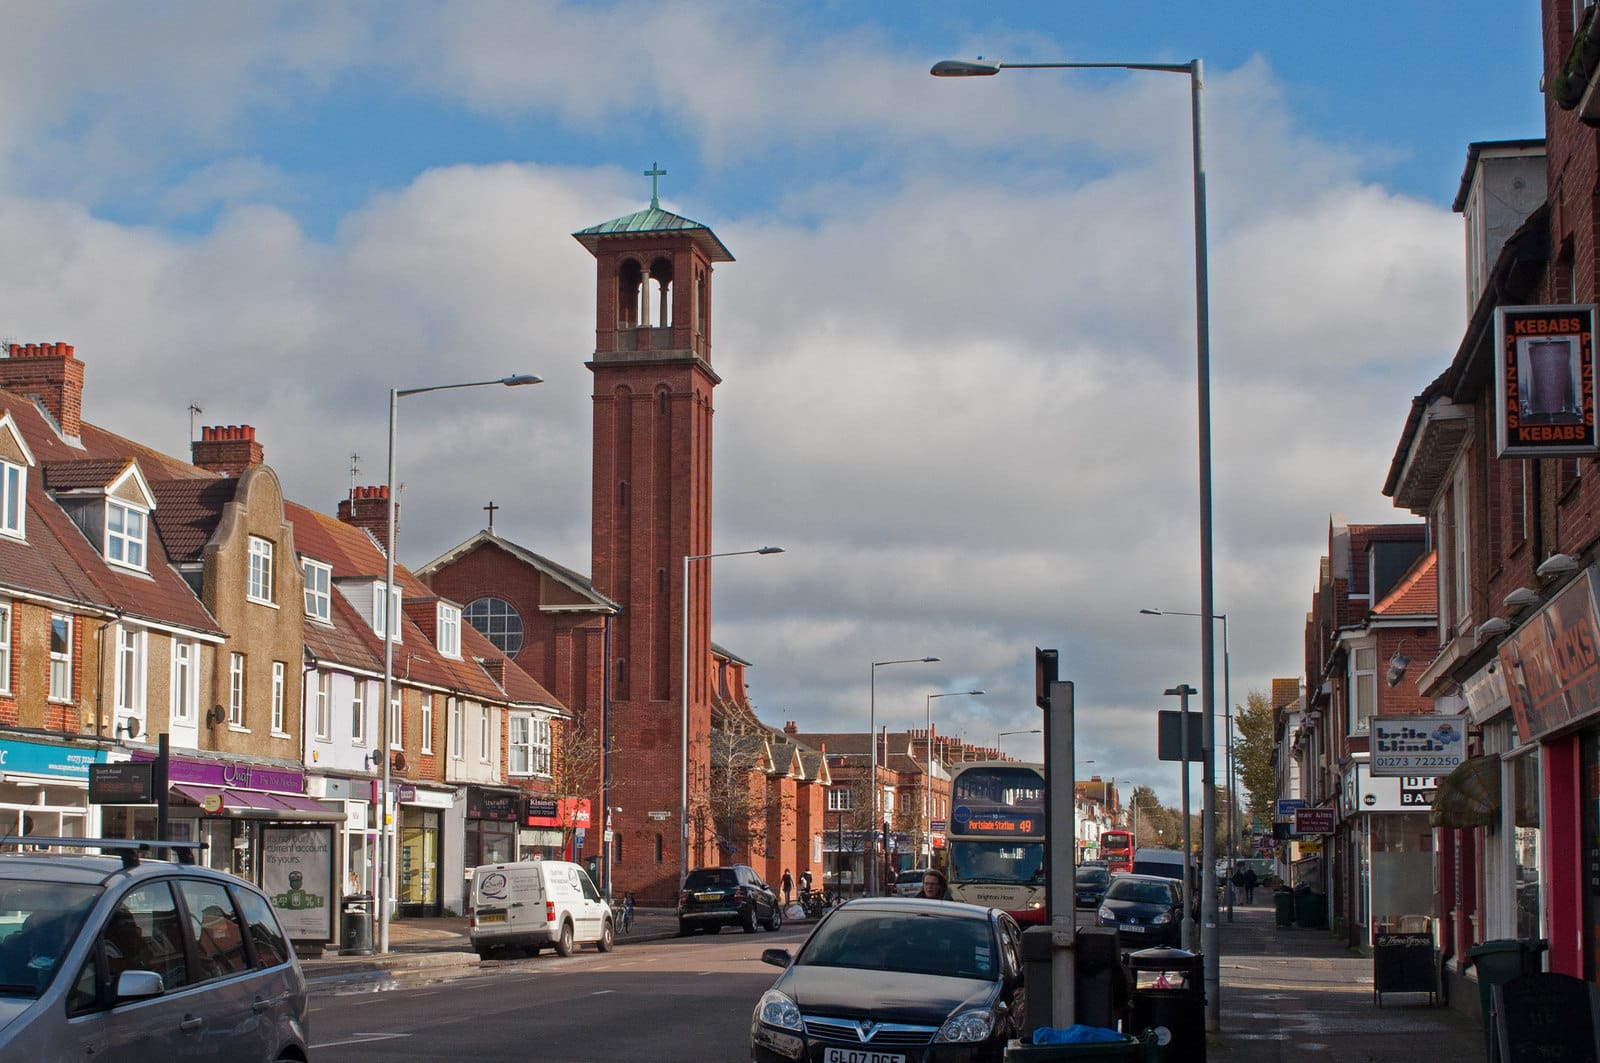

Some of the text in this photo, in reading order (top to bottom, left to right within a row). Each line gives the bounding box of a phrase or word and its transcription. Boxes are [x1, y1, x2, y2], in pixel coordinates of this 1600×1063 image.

[1514, 318, 1580, 333] KEBABS
[1505, 335, 1518, 429] PIZZAS
[1581, 332, 1594, 426] PIZZAS
[1519, 426, 1585, 441] KEBABS
[1376, 727, 1427, 739] brite
[1377, 740, 1444, 752] blinds
[1377, 757, 1460, 766] 01273 722250
[223, 760, 253, 788] Quaff
[1403, 793, 1425, 803] BA
[995, 820, 1015, 830] Station
[1019, 819, 1032, 832] 49
